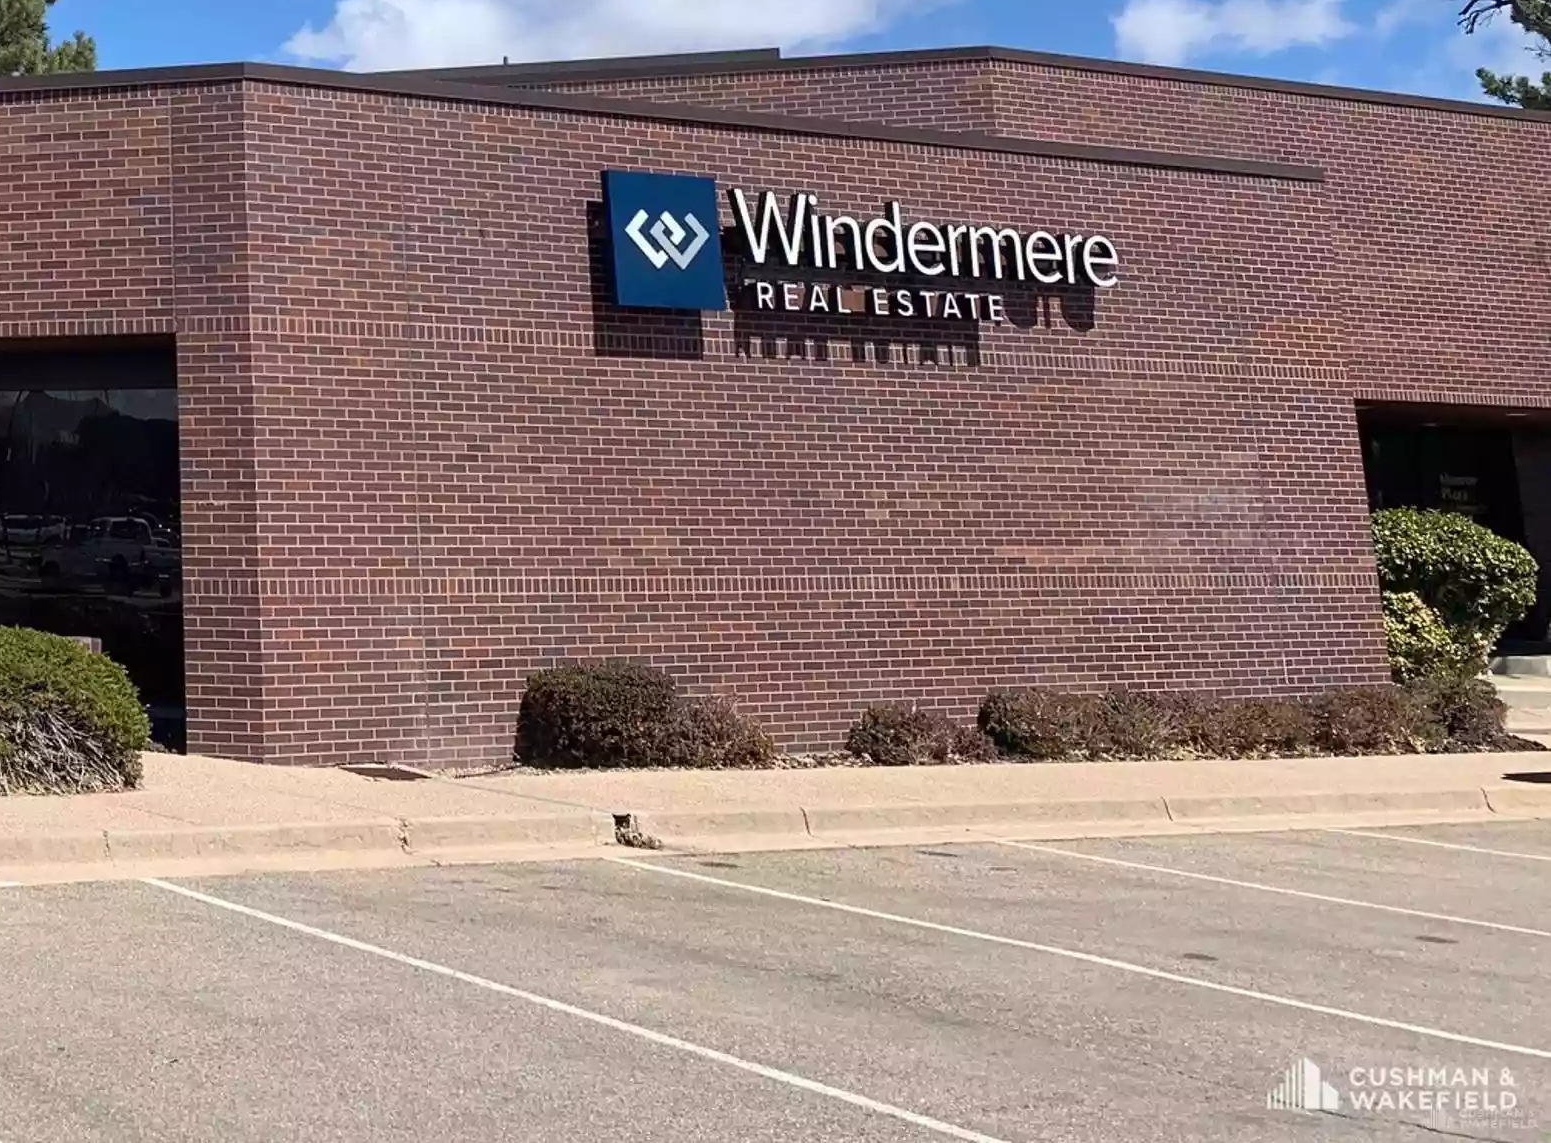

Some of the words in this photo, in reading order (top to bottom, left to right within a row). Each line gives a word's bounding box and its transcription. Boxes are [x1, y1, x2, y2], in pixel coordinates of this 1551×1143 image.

[732, 187, 1119, 288] Windermere
[756, 281, 852, 314] REAL
[873, 288, 1004, 322] ESTATE
